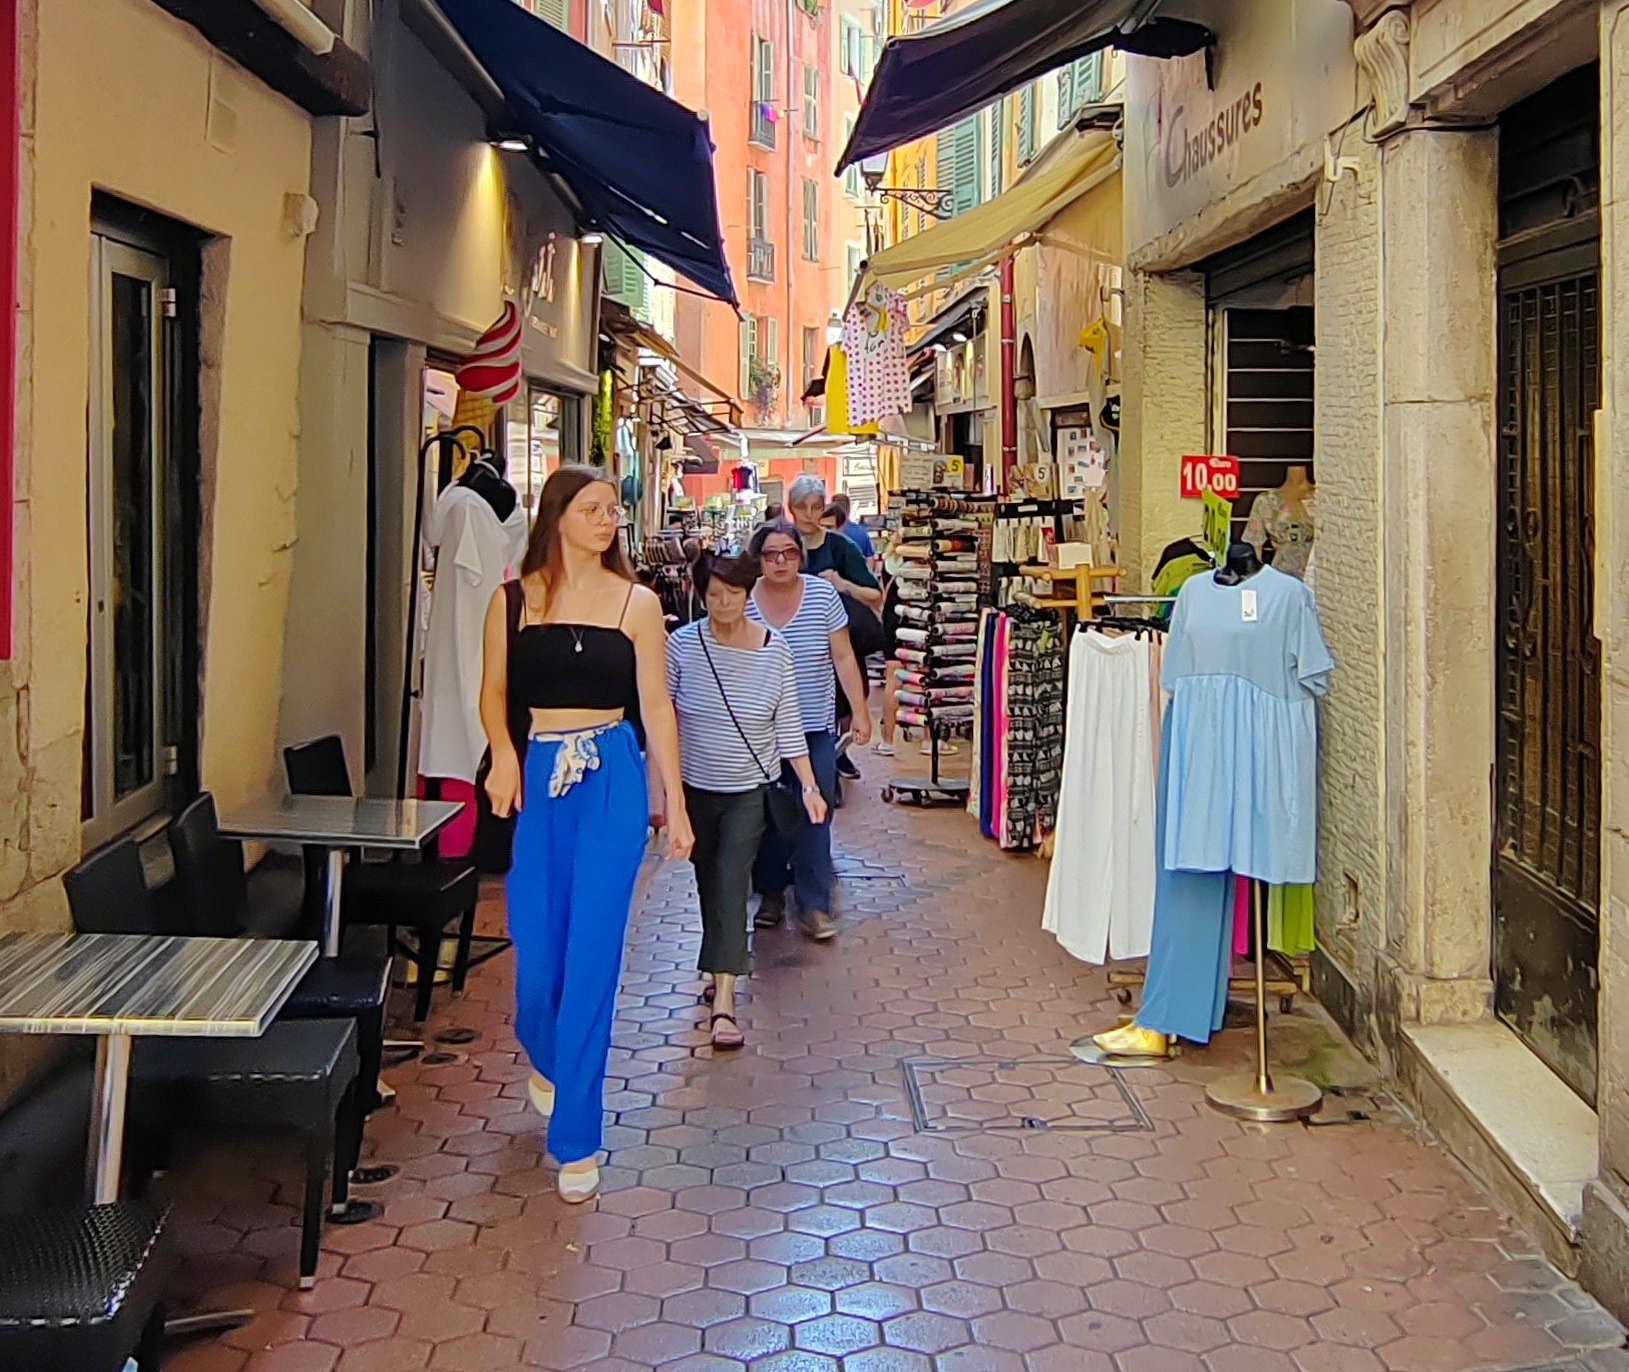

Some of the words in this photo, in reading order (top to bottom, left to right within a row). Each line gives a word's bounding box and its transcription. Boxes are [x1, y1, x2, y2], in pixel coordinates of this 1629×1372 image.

[1165, 81, 1263, 188] Chaussures
[951, 459, 959, 472] 5
[1038, 467, 1046, 479] 5
